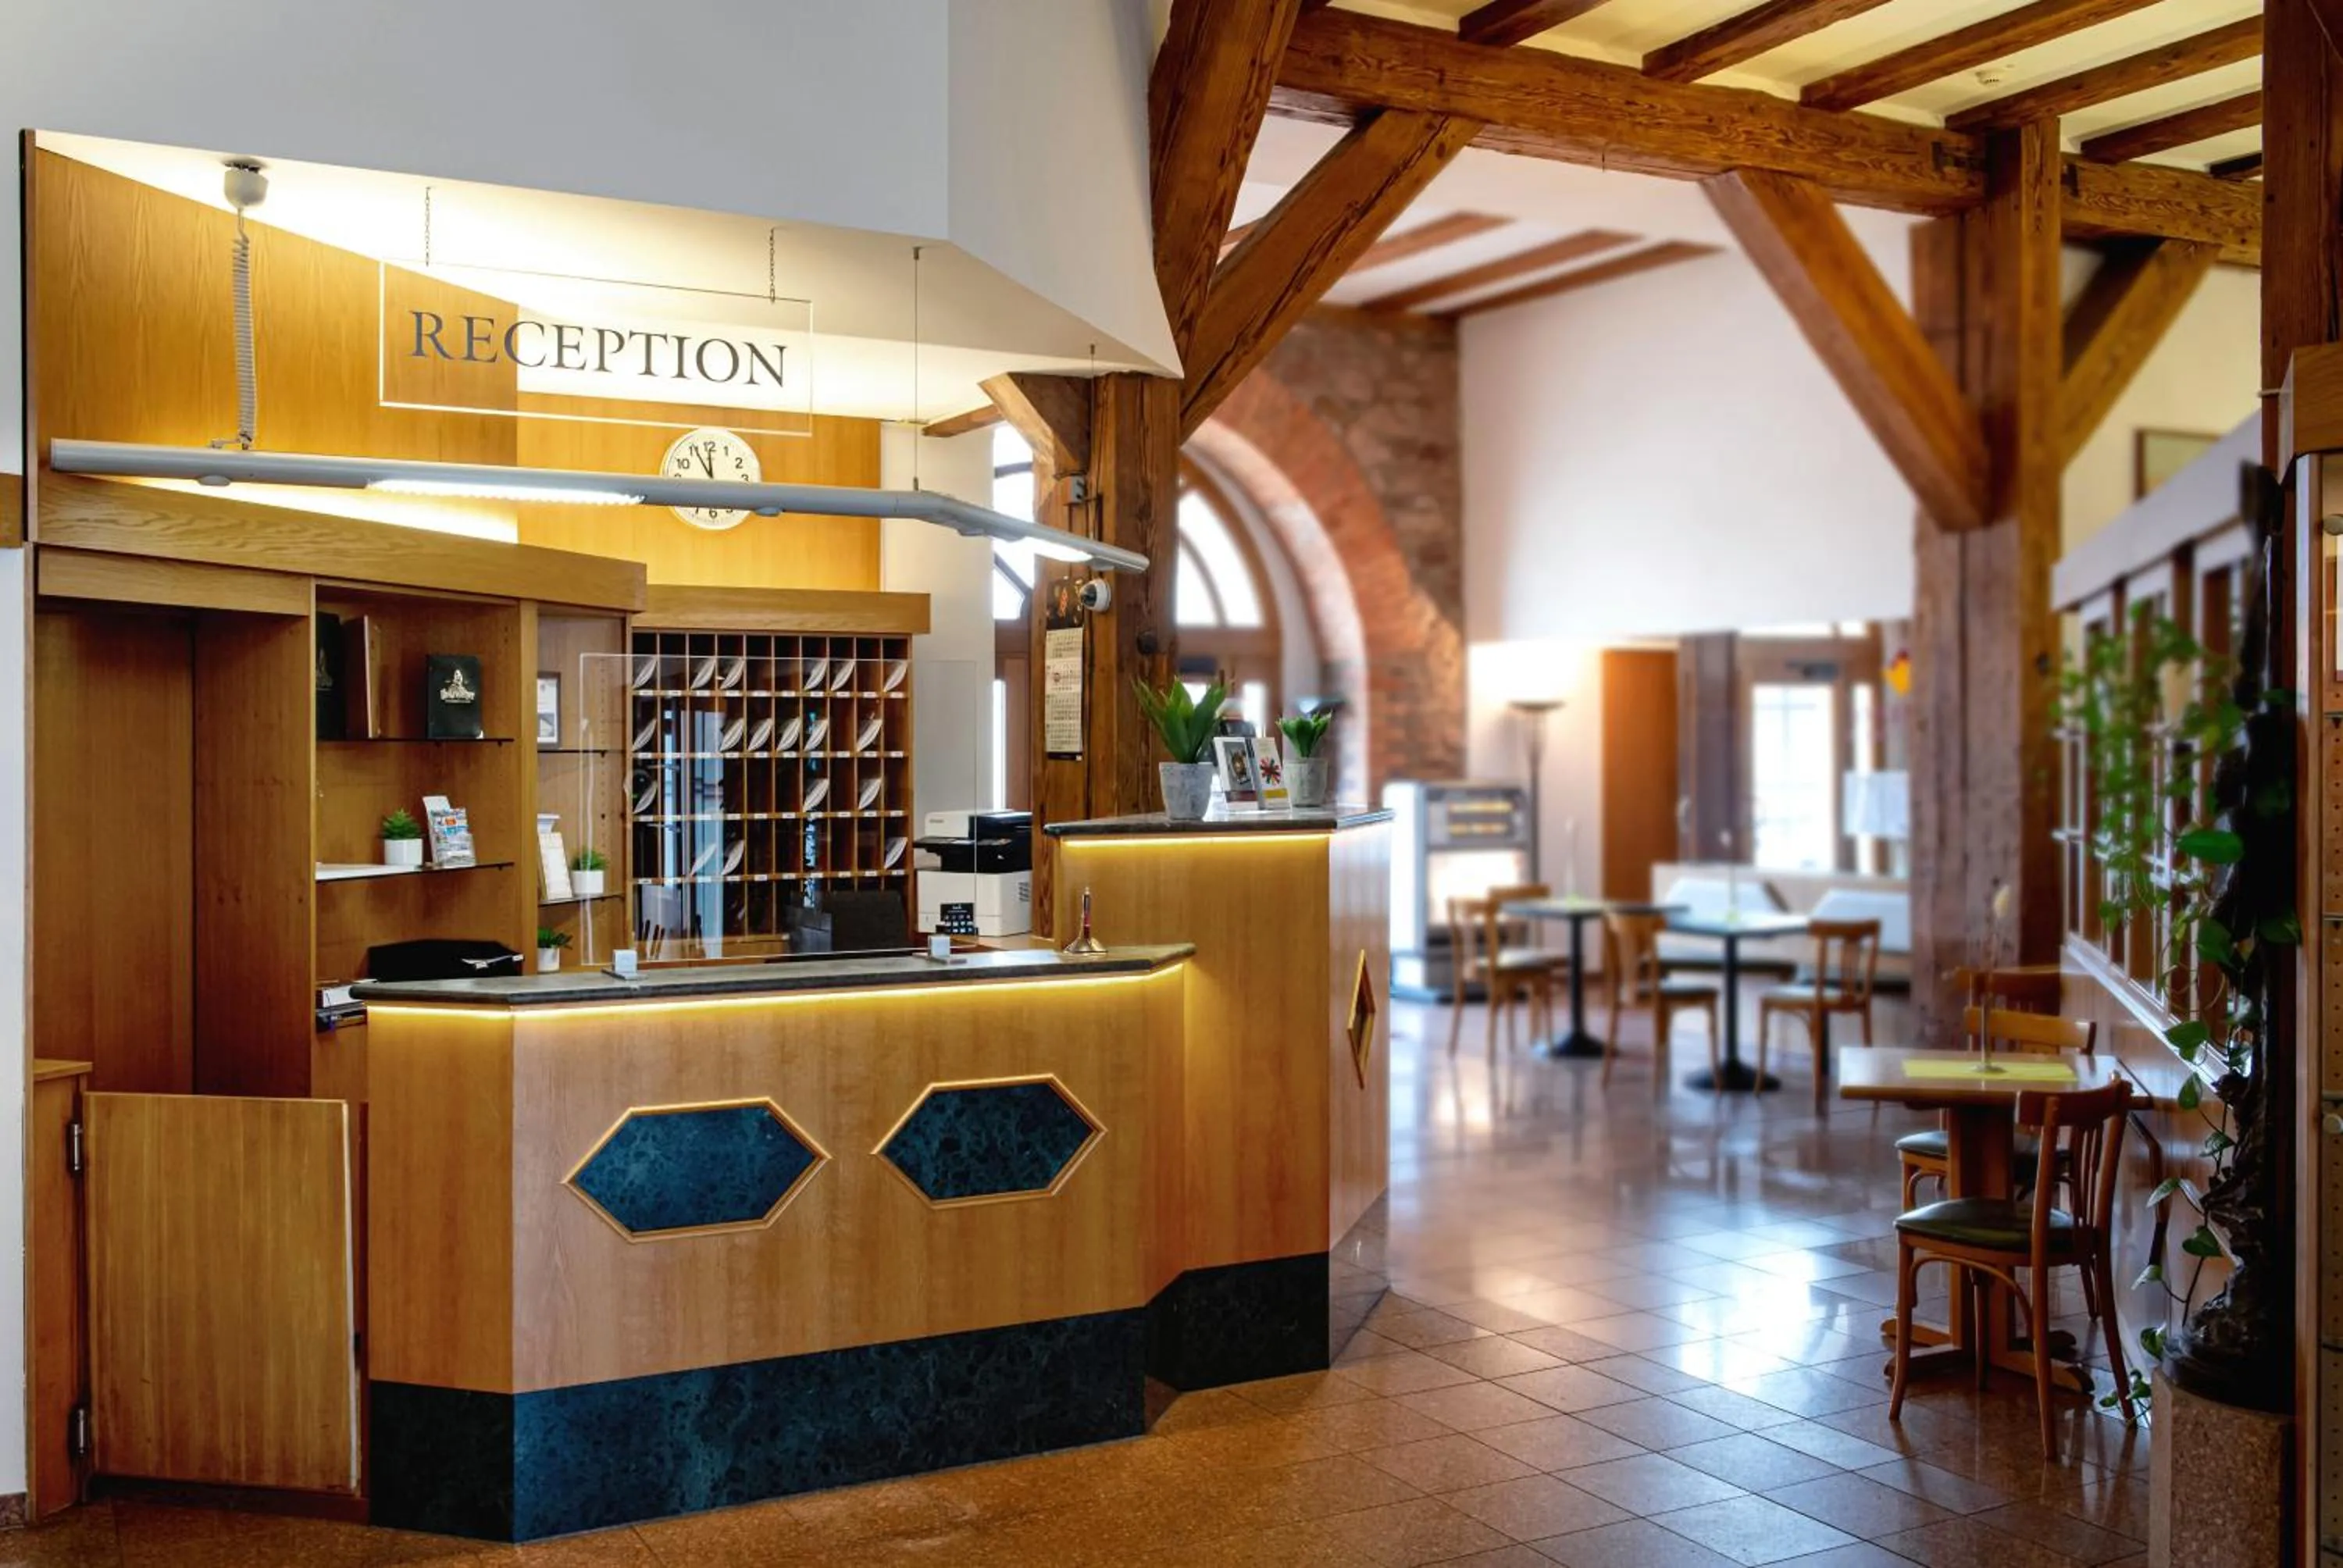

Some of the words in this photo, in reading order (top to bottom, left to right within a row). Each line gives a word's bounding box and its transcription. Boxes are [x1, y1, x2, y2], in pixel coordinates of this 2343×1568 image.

[410, 310, 787, 387] RECEPTION
[704, 441, 716, 452] 12
[723, 445, 729, 456] 1
[676, 458, 690, 469] 10
[735, 458, 743, 469] 2
[709, 508, 718, 519] 6
